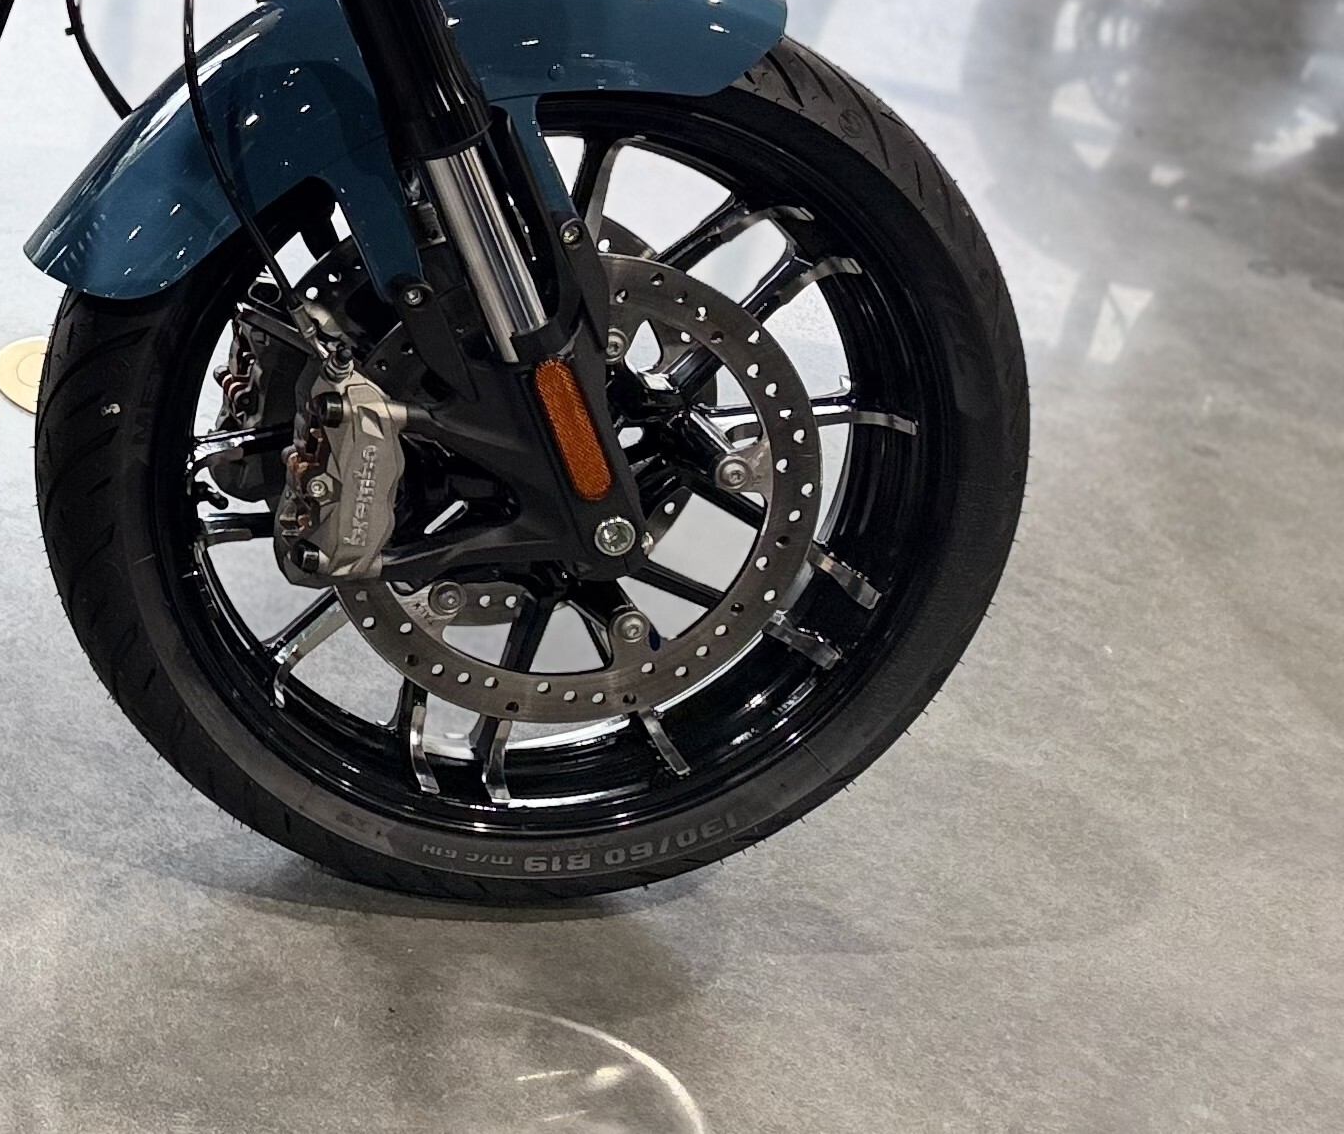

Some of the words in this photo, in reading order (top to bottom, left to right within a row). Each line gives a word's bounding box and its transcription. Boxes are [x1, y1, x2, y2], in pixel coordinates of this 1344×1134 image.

[344, 445, 377, 546] brembo
[523, 852, 592, 873] B19
[605, 814, 739, 866] 130/60
